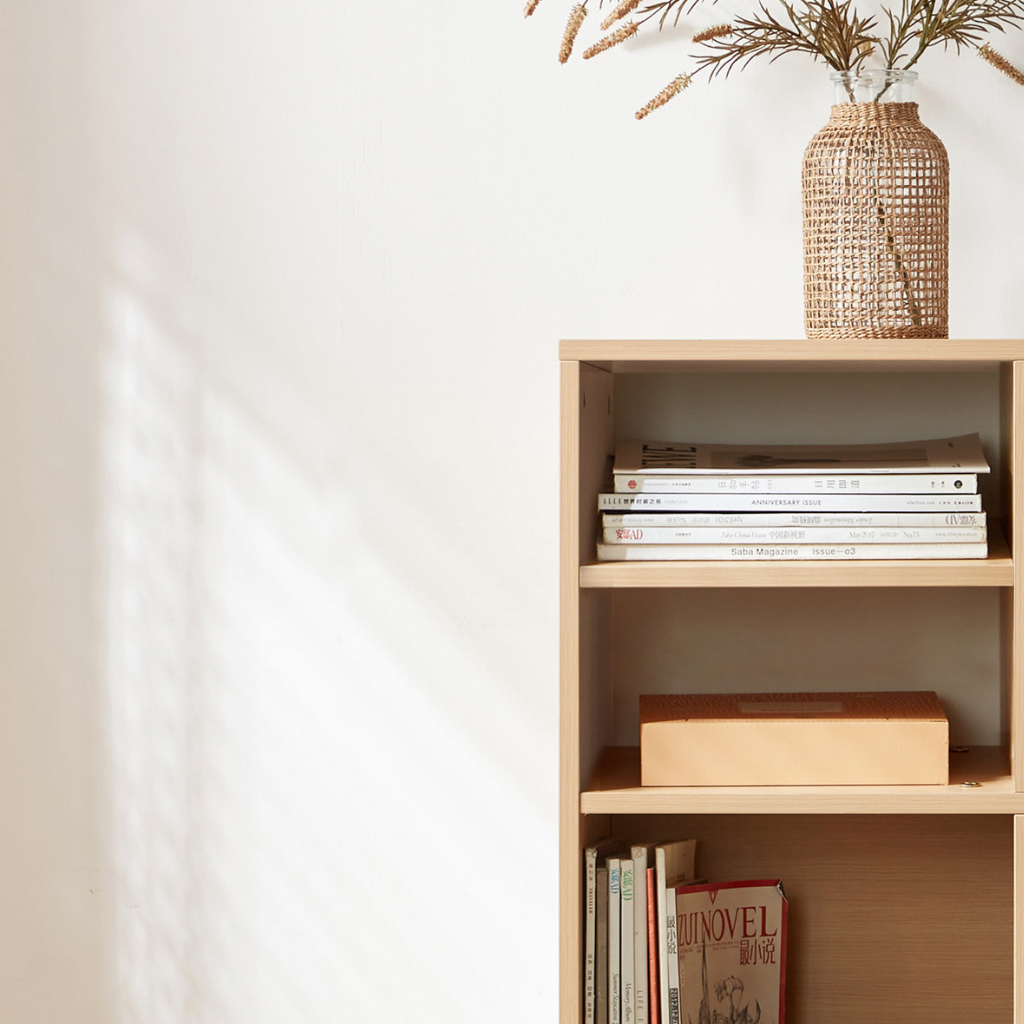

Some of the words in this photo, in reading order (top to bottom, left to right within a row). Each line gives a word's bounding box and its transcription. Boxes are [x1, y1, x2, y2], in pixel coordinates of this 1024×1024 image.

[616, 529, 643, 540] 安邸AD
[731, 547, 753, 555] Saba
[756, 547, 799, 557] Magazine
[666, 915, 677, 955] 最小说
[739, 938, 777, 966] 最小说
